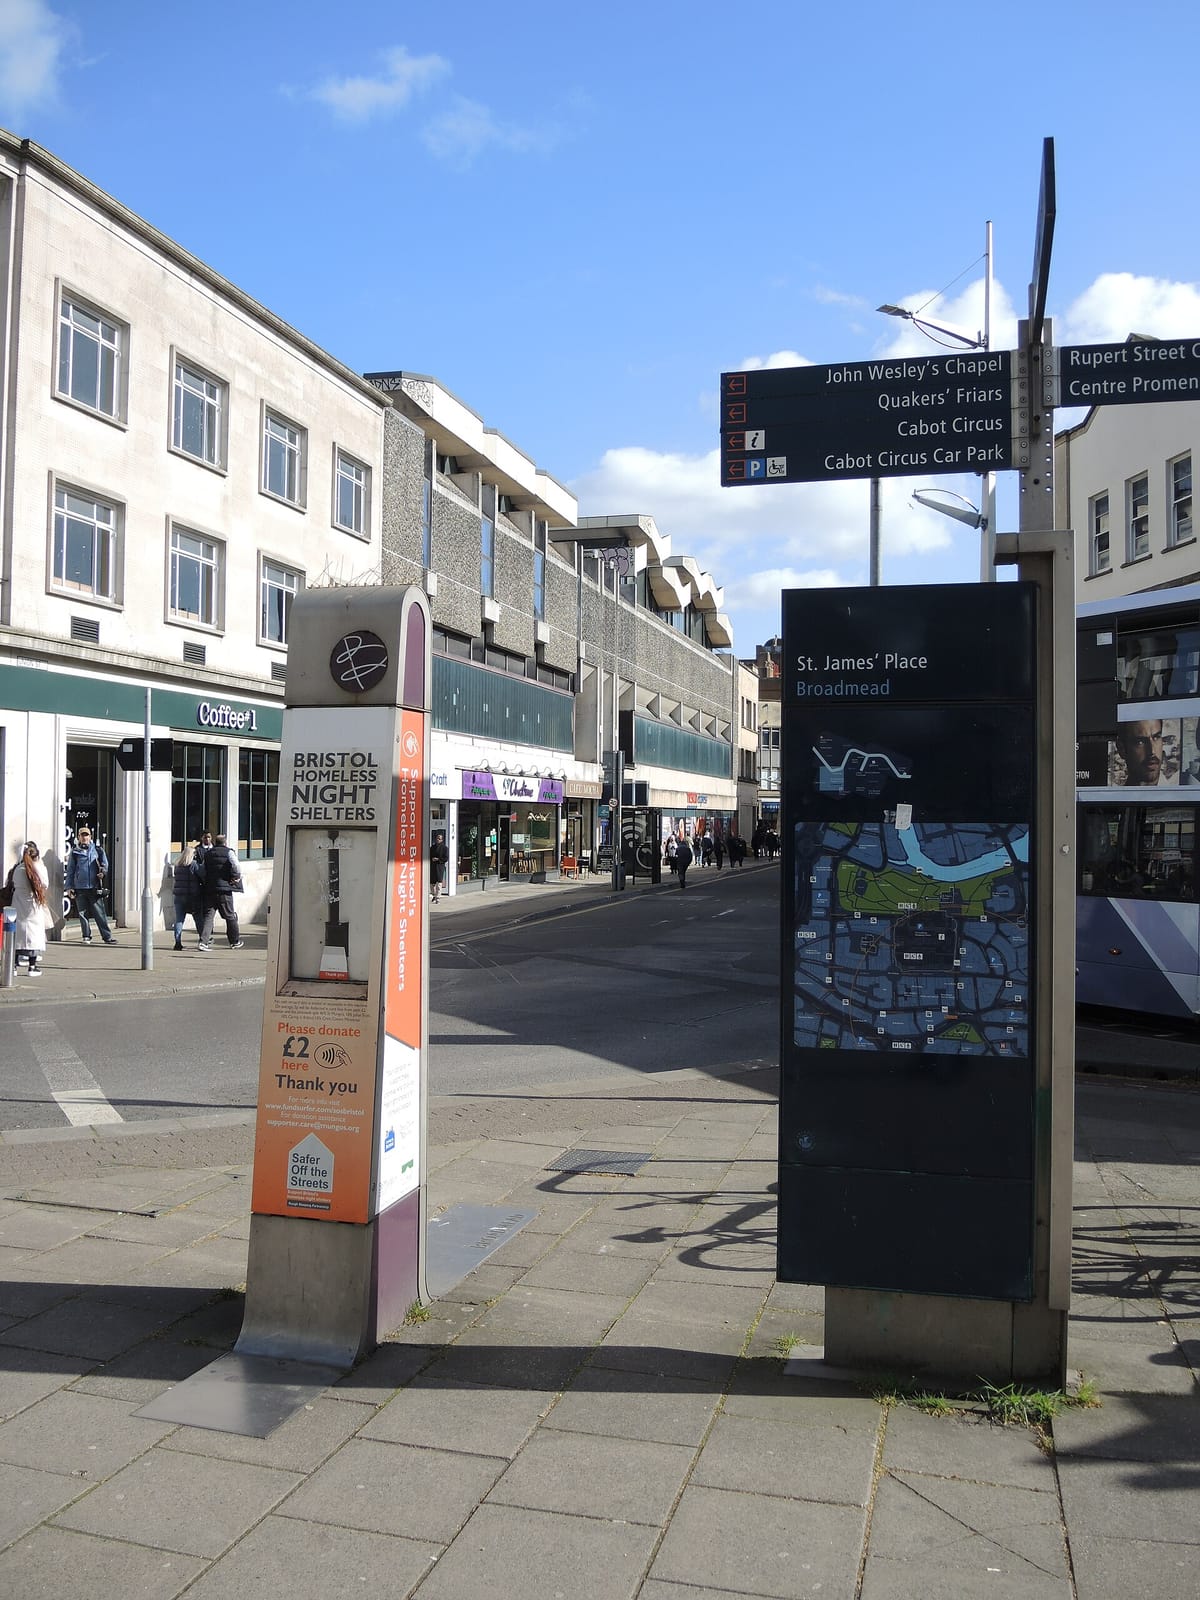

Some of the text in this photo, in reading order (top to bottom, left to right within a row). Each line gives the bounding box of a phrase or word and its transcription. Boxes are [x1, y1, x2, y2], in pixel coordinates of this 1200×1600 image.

[1070, 348, 1128, 369] Rupert
[1133, 344, 1186, 362] Street
[826, 354, 1002, 384] John Wesley's Chapel
[1069, 376, 1199, 396] Centre Promen
[878, 387, 1003, 411] Quakers' Friars
[897, 416, 1003, 437] Cabot Circus
[824, 444, 1004, 470] Cabot Circus Car Park
[797, 653, 928, 671] St. James' Place
[796, 679, 890, 696] Broadmead
[293, 752, 378, 768] BRISTOL
[293, 770, 377, 782] HOMELESS
[291, 784, 377, 804] NIGHT
[290, 807, 375, 820] SHELTERS
[408, 768, 419, 917] Support Bristol's
[397, 767, 409, 991] Homeless Night Shelters
[277, 1022, 361, 1037] Please donate
[282, 1035, 310, 1058] £2
[281, 1059, 309, 1071] here
[275, 1073, 358, 1096] Thank you
[291, 1152, 321, 1165] Safer
[291, 1164, 328, 1178] Off the
[290, 1176, 329, 1189] Streets
